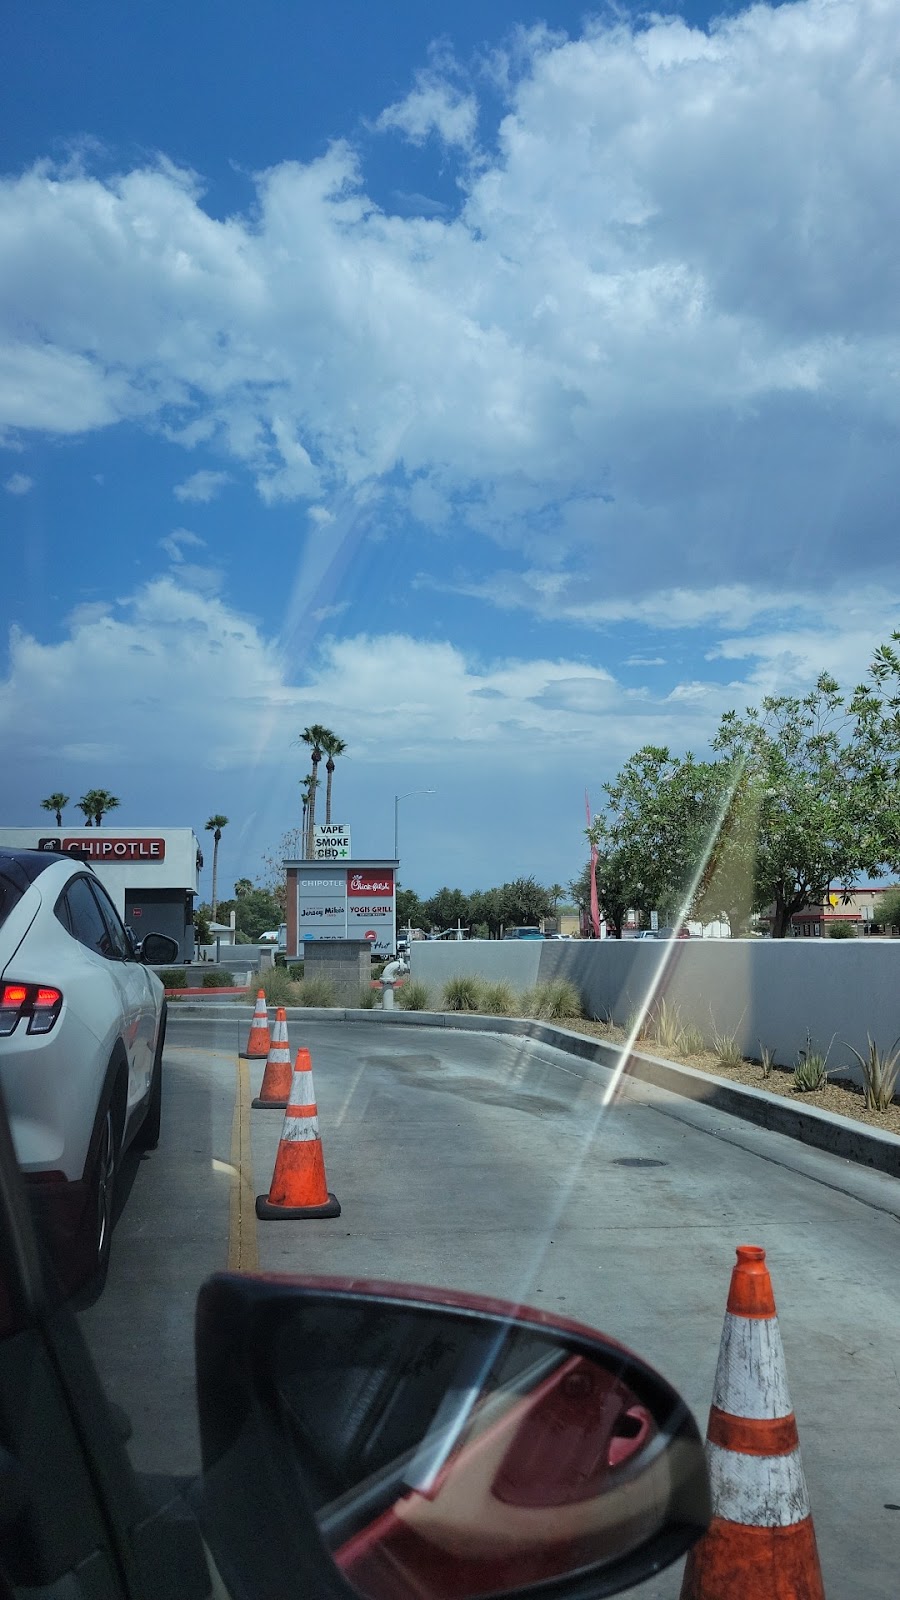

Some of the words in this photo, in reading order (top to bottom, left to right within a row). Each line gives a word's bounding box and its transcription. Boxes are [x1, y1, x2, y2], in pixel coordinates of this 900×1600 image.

[320, 826, 344, 834] VAPE
[316, 838, 349, 847] SMOKE
[67, 842, 160, 855] CHIPOTLE
[301, 909, 324, 917] Jersey
